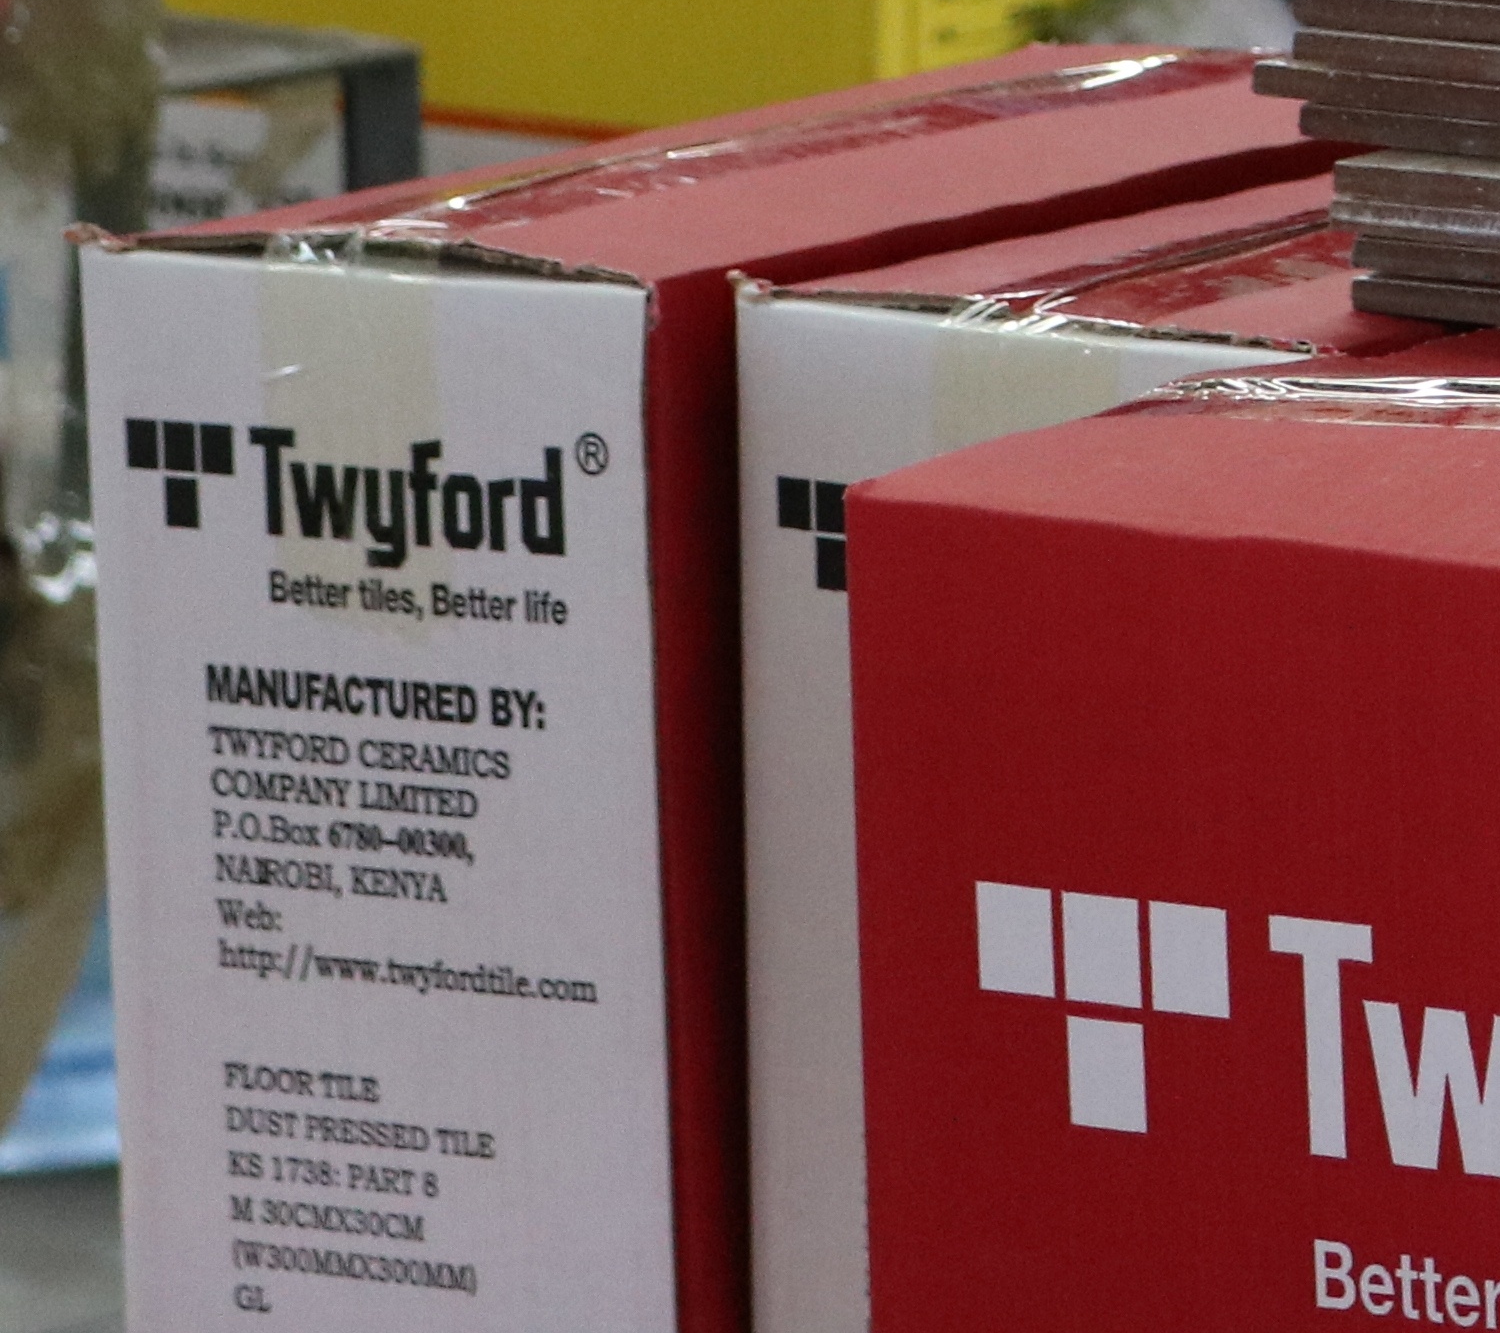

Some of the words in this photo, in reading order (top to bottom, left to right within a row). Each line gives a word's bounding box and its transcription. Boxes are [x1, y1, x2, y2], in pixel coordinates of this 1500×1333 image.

[268, 569, 352, 608] Better
[358, 578, 425, 621] tiles,
[432, 582, 517, 623] Better
[524, 589, 570, 625] life
[206, 663, 478, 725] MANUFACTURED
[490, 688, 546, 730] BY:
[208, 725, 349, 766] TWYFORD
[358, 739, 511, 780] CERAMICS
[210, 767, 350, 809] COMPANY
[358, 781, 479, 819] LIMITED
[215, 853, 344, 899] NAIROBI,
[349, 865, 448, 902] KENYA
[215, 898, 284, 932] Web:
[217, 937, 598, 1004] http://www.twyfordtile.com
[224, 1062, 315, 1096] FLOOR
[319, 1071, 380, 1103] TILE
[226, 1104, 297, 1138] DUST
[305, 1114, 431, 1153] PRESSED
[437, 1128, 497, 1160] TILE
[227, 1149, 264, 1179] KS
[348, 1163, 416, 1196] PART
[229, 1195, 255, 1223] M
